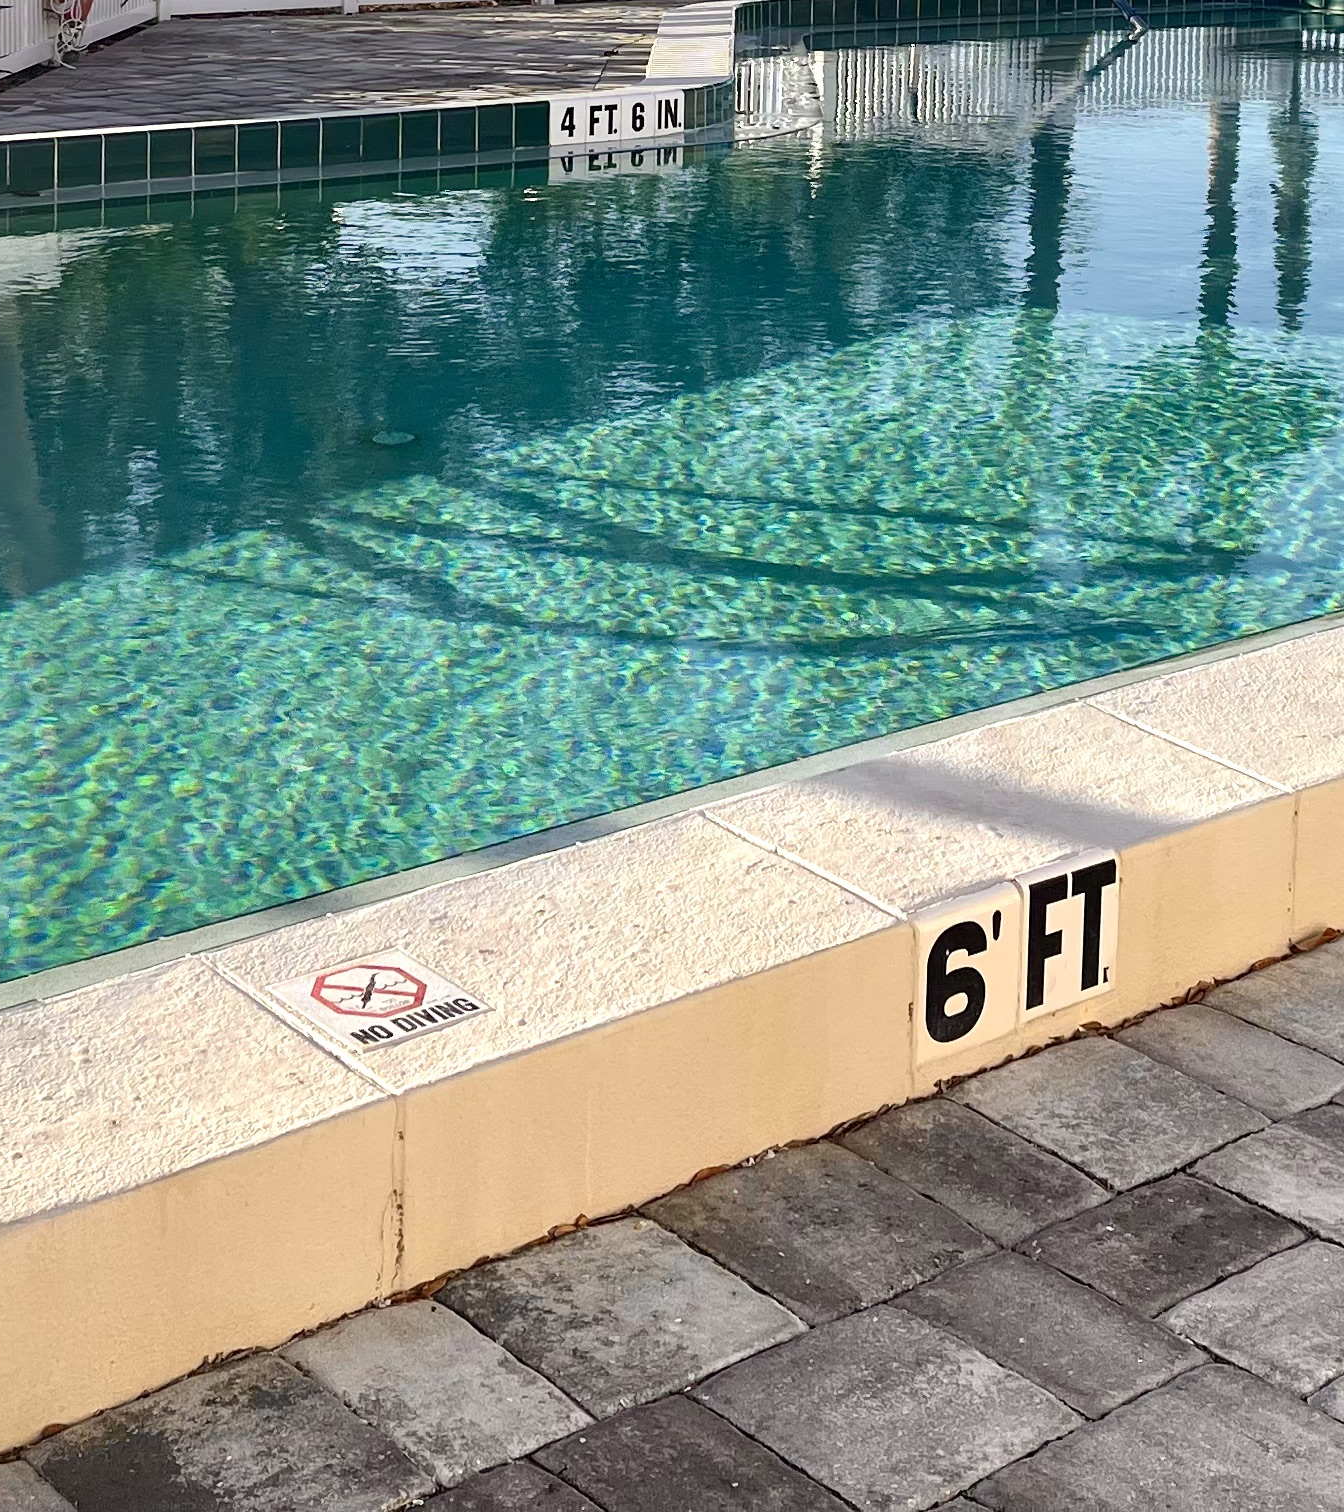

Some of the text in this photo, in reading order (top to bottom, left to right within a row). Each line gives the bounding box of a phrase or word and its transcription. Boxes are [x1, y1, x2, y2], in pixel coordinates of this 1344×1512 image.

[560, 98, 682, 137] 4 FT. 6 IN.
[926, 910, 1002, 1043] 6'
[350, 1024, 394, 1044] NO
[390, 998, 480, 1032] DIVING
